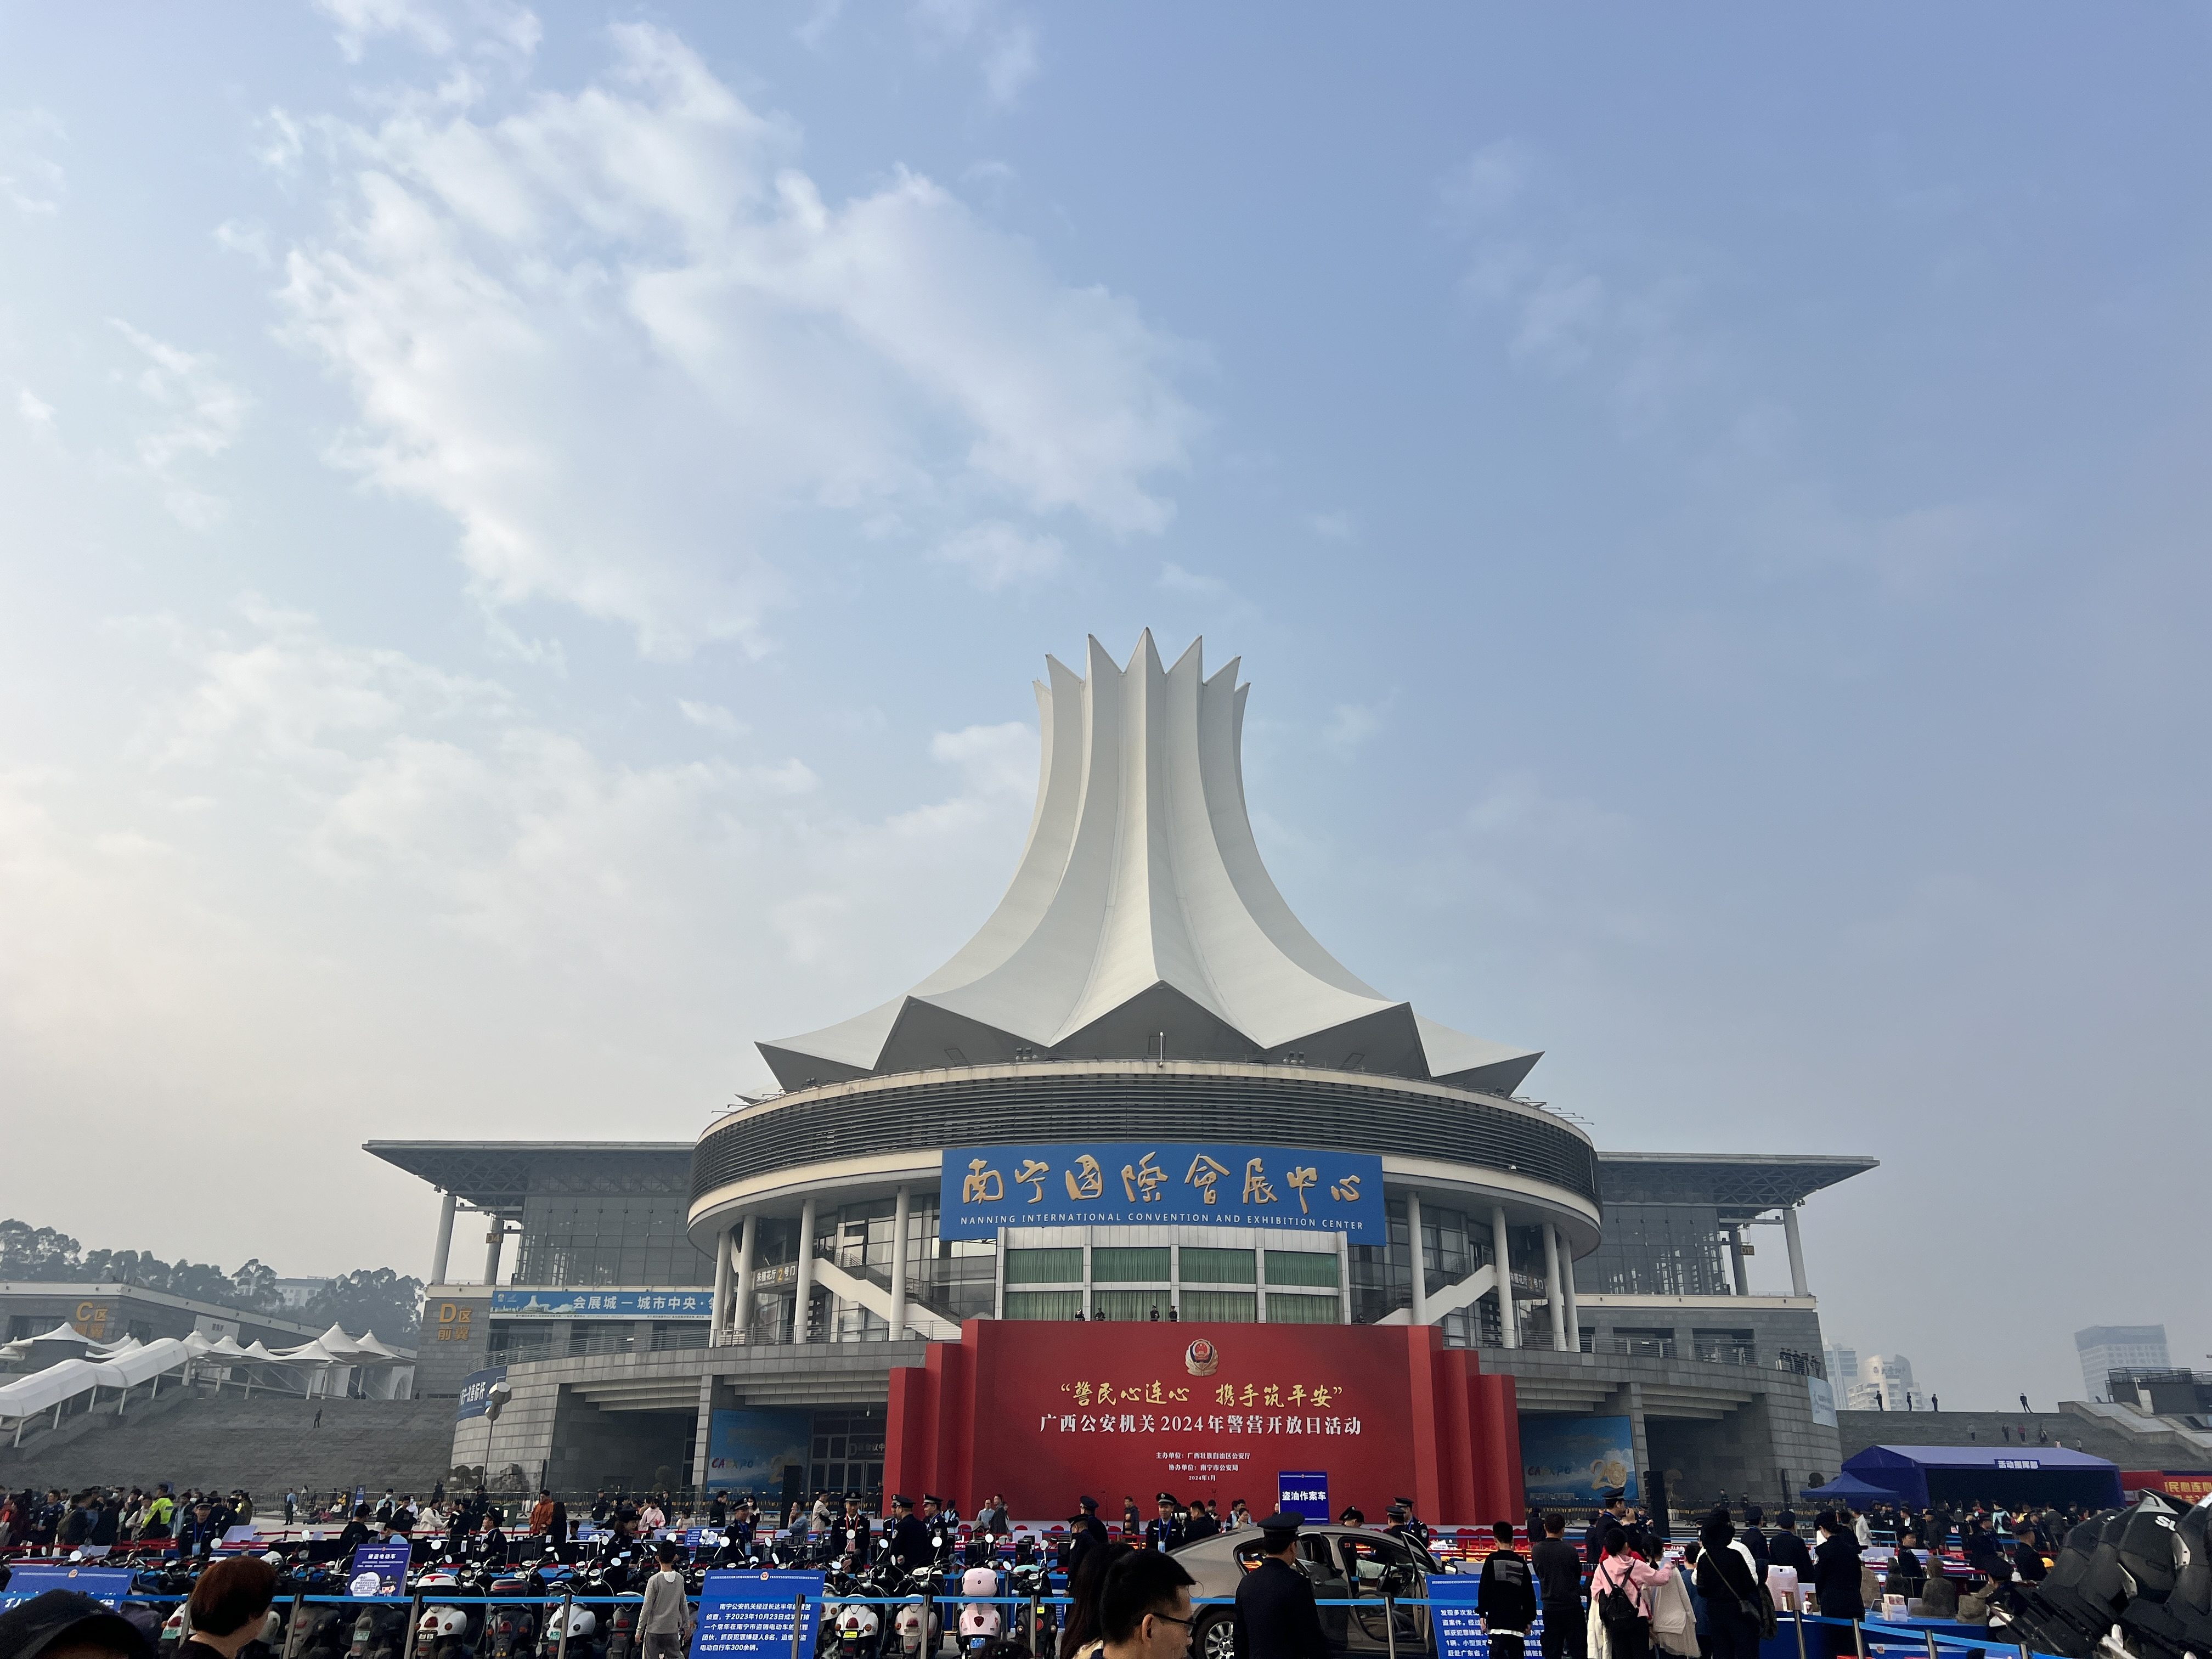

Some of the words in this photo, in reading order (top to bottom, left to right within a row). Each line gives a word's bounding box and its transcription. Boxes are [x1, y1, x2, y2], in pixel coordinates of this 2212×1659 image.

[961, 1215, 1015, 1225] NANNING
[1022, 1212, 1121, 1223] INTERNATIONAL
[1128, 1212, 1209, 1223] CONVENTION
[1216, 1214, 1240, 1223] AND
[1247, 1215, 1316, 1227] EXHIBITION
[1322, 1220, 1363, 1230] CENTER
[486, 1234, 501, 1243] D4
[76, 1302, 108, 1322] C区
[439, 1303, 472, 1323] D区
[438, 1325, 469, 1341] 前翼
[1282, 1491, 1327, 1501] 盗油作案车
